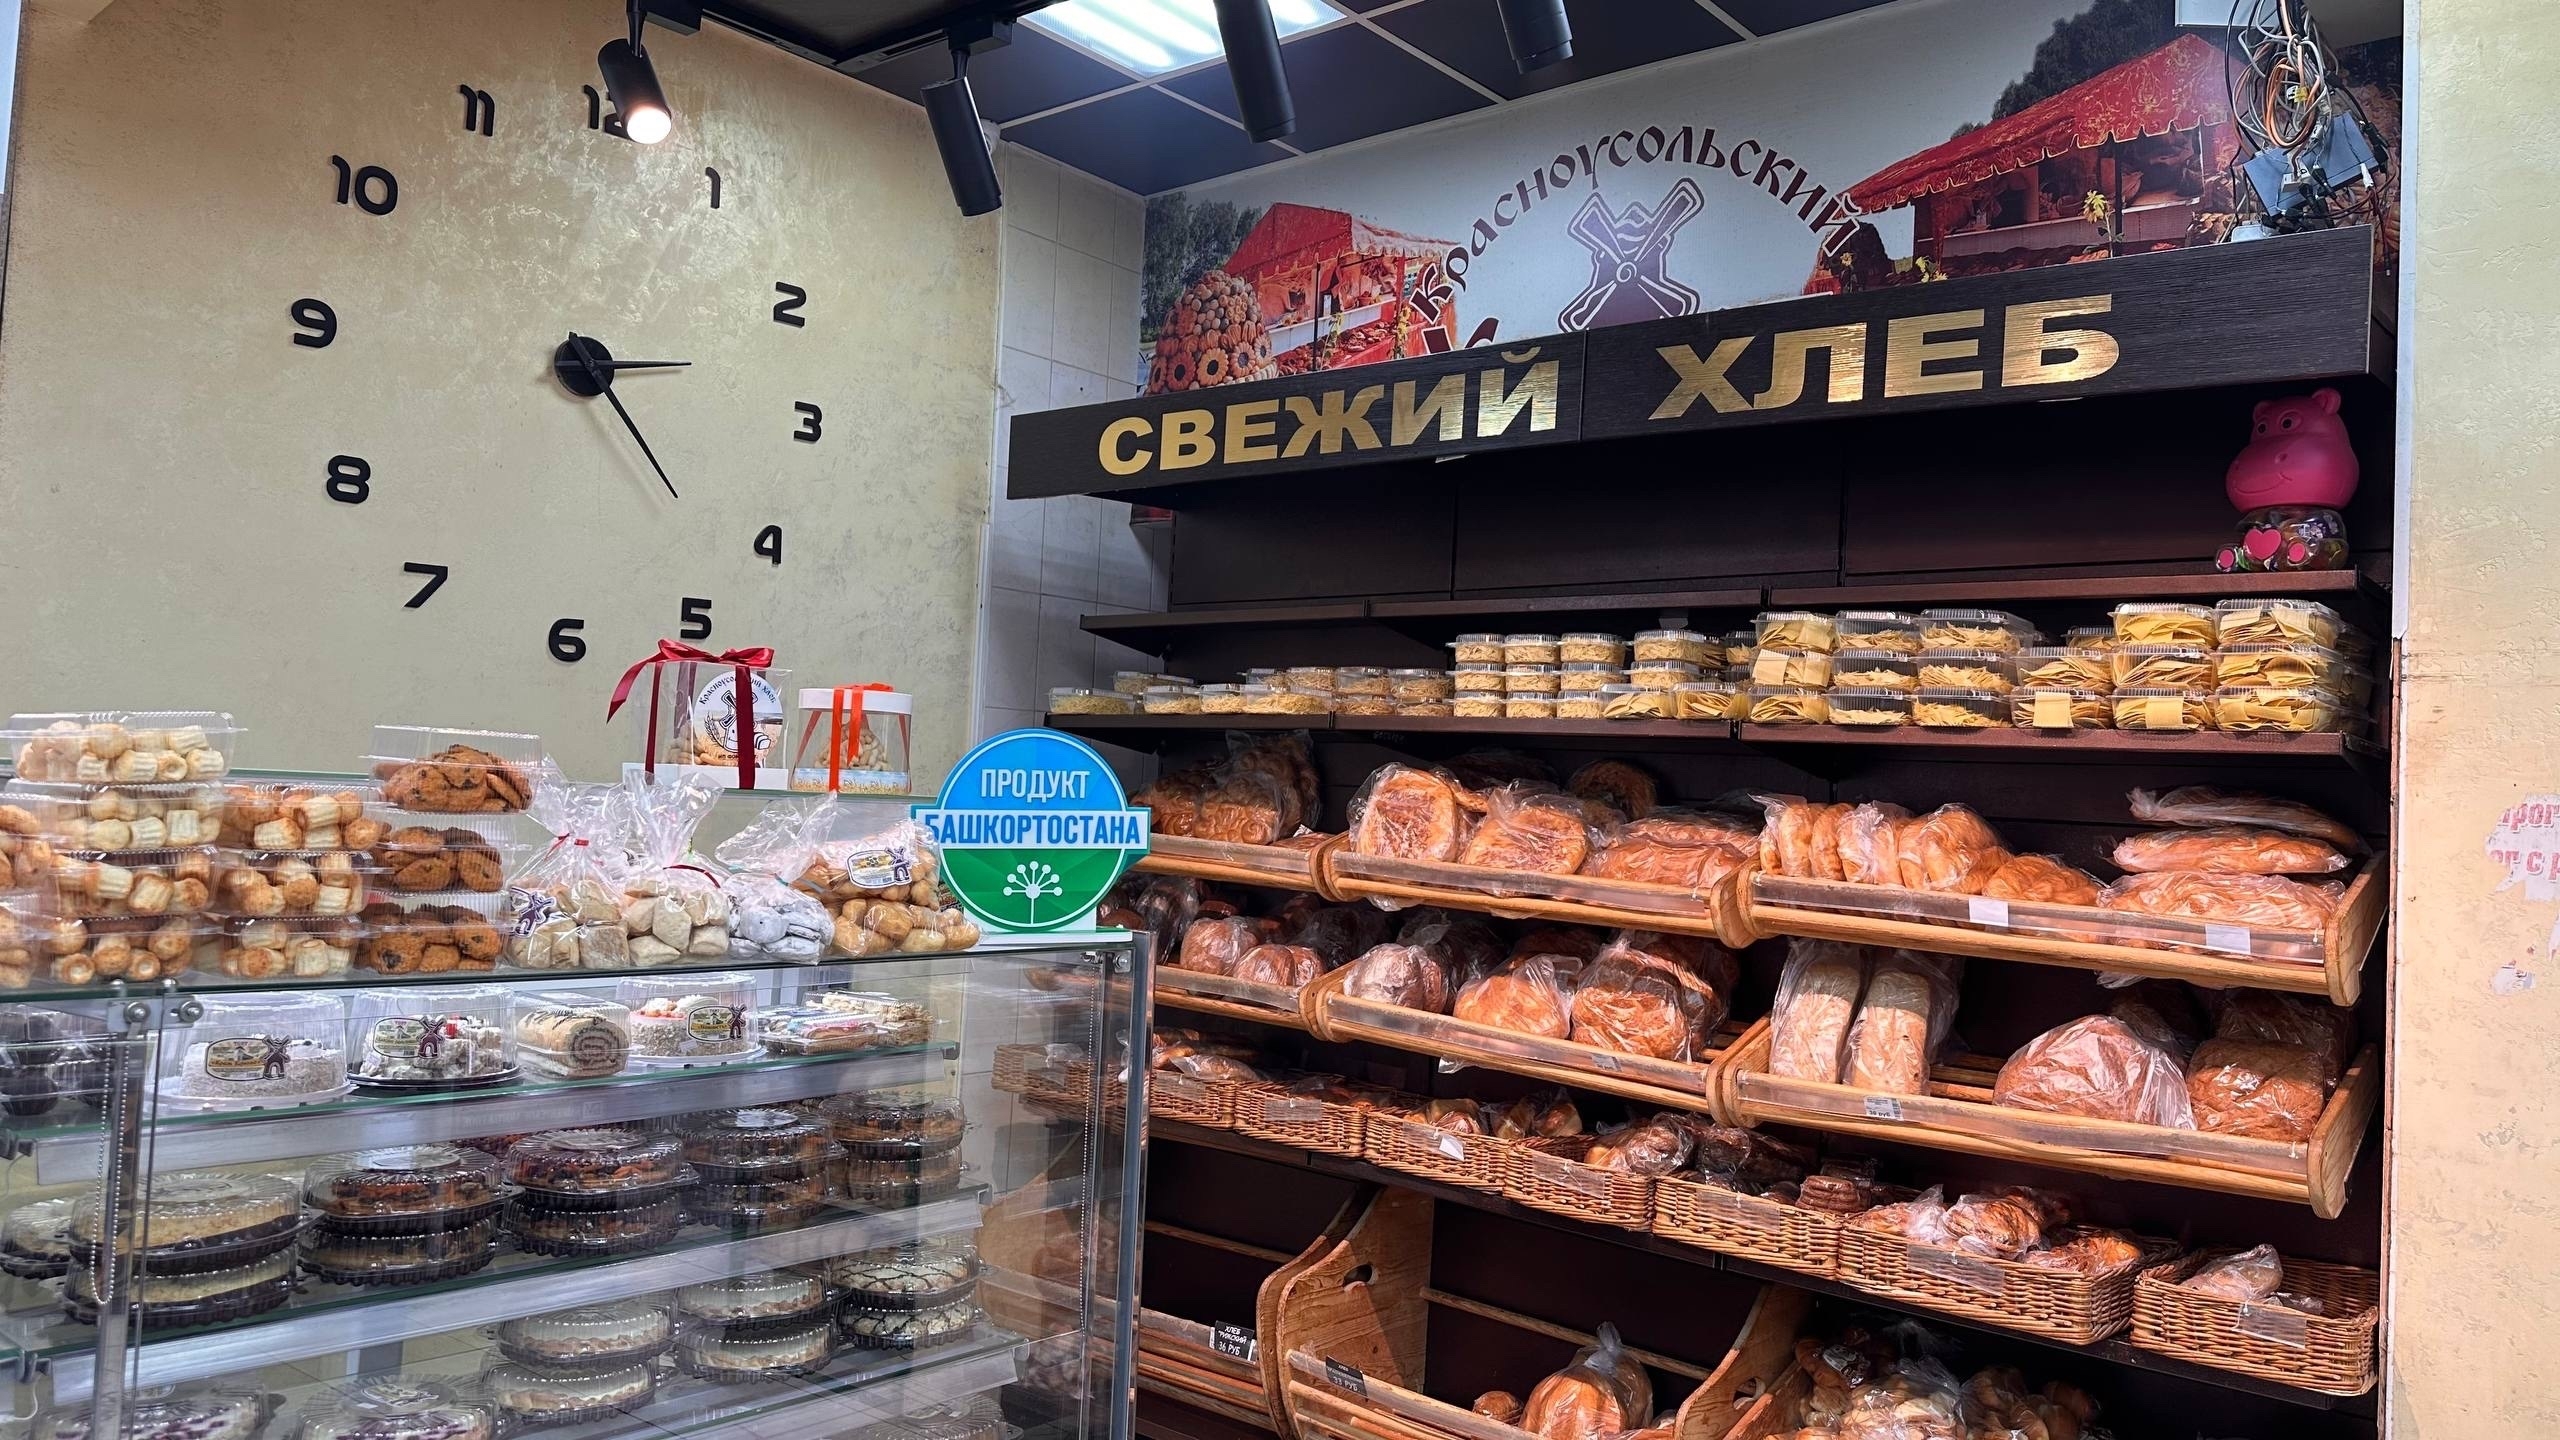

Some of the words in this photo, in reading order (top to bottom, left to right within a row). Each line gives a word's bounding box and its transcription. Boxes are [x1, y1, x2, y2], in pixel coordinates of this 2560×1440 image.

[460, 84, 495, 136] 11
[331, 154, 399, 216] 10
[705, 167, 721, 209] 1
[290, 298, 338, 349] 9
[773, 281, 807, 328] 2
[1098, 347, 1560, 476] СВЕЖИЙ
[1649, 291, 2120, 420] ХЛЕБ
[793, 401, 823, 442] 3
[326, 454, 371, 505] 8
[753, 524, 782, 565] 4
[403, 562, 449, 609] 7
[548, 618, 587, 663] 6
[680, 597, 712, 640] 5
[981, 769, 1091, 803] ПРОДУКТ
[926, 814, 1141, 844] БАШКОРТОСТАНА
[1218, 1341, 1226, 1352] 36
